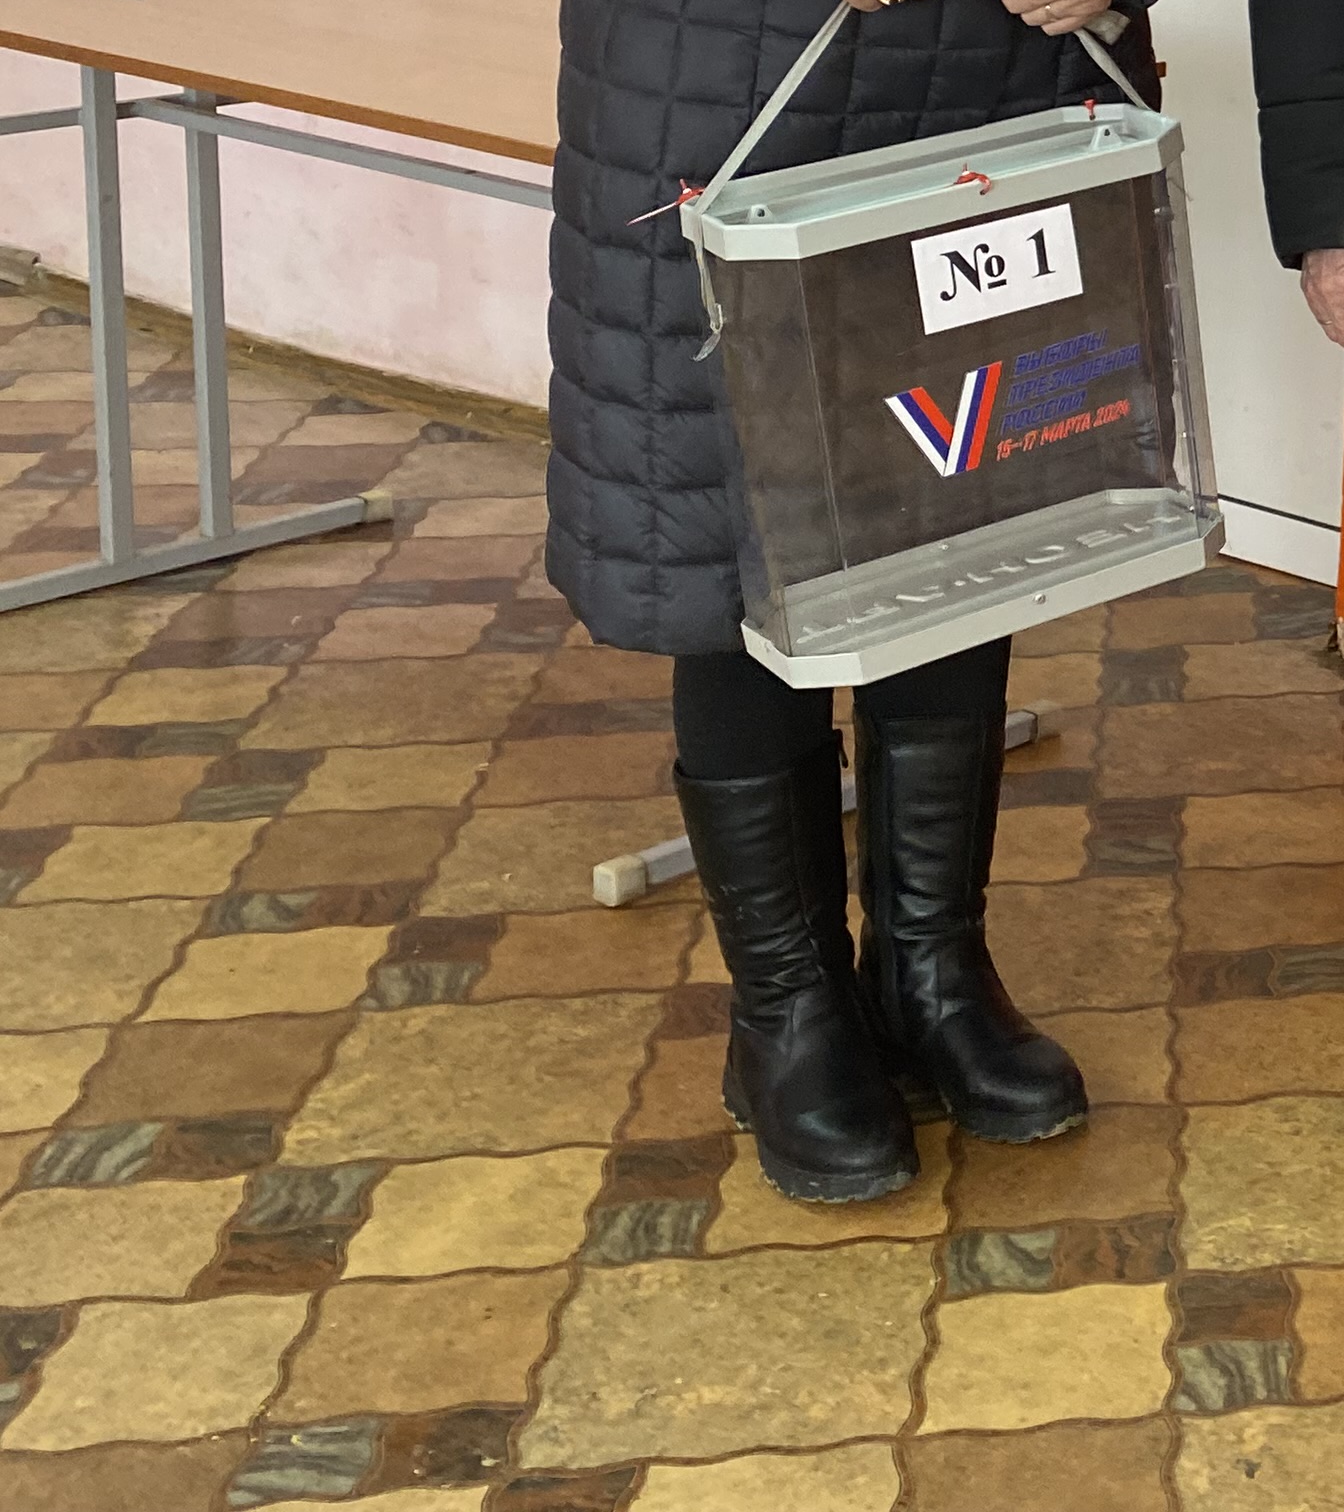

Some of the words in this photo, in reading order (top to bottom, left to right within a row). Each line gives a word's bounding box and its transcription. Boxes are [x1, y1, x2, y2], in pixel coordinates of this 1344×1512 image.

[1026, 228, 1056, 278] 1
[1007, 344, 1140, 406] ПРЕЗИДЕНТА
[1015, 330, 1107, 375] ВЫБОРЫ
[1002, 390, 1086, 433] РОССИИ
[1040, 412, 1091, 446] МАРТА
[1093, 399, 1130, 428] 2024
